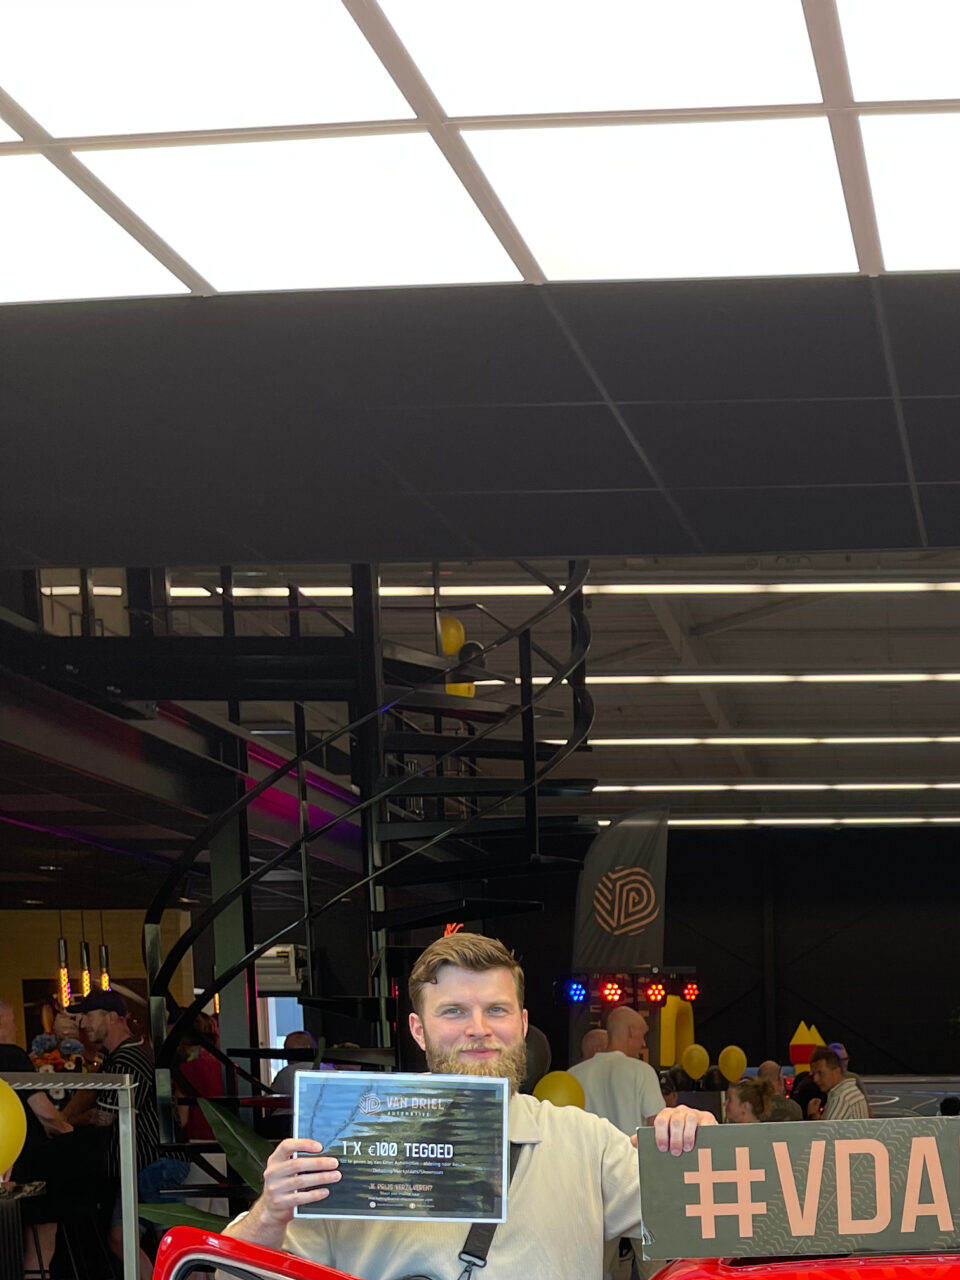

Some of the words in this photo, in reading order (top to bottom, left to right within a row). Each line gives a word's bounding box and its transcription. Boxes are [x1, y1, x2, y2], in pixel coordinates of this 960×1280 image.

[386, 1096, 408, 1109] VAN
[411, 1096, 444, 1111] DRIEL
[342, 1141, 347, 1156] 1
[352, 1142, 362, 1156] X
[367, 1142, 398, 1157] €100
[404, 1143, 454, 1159] TEGOED
